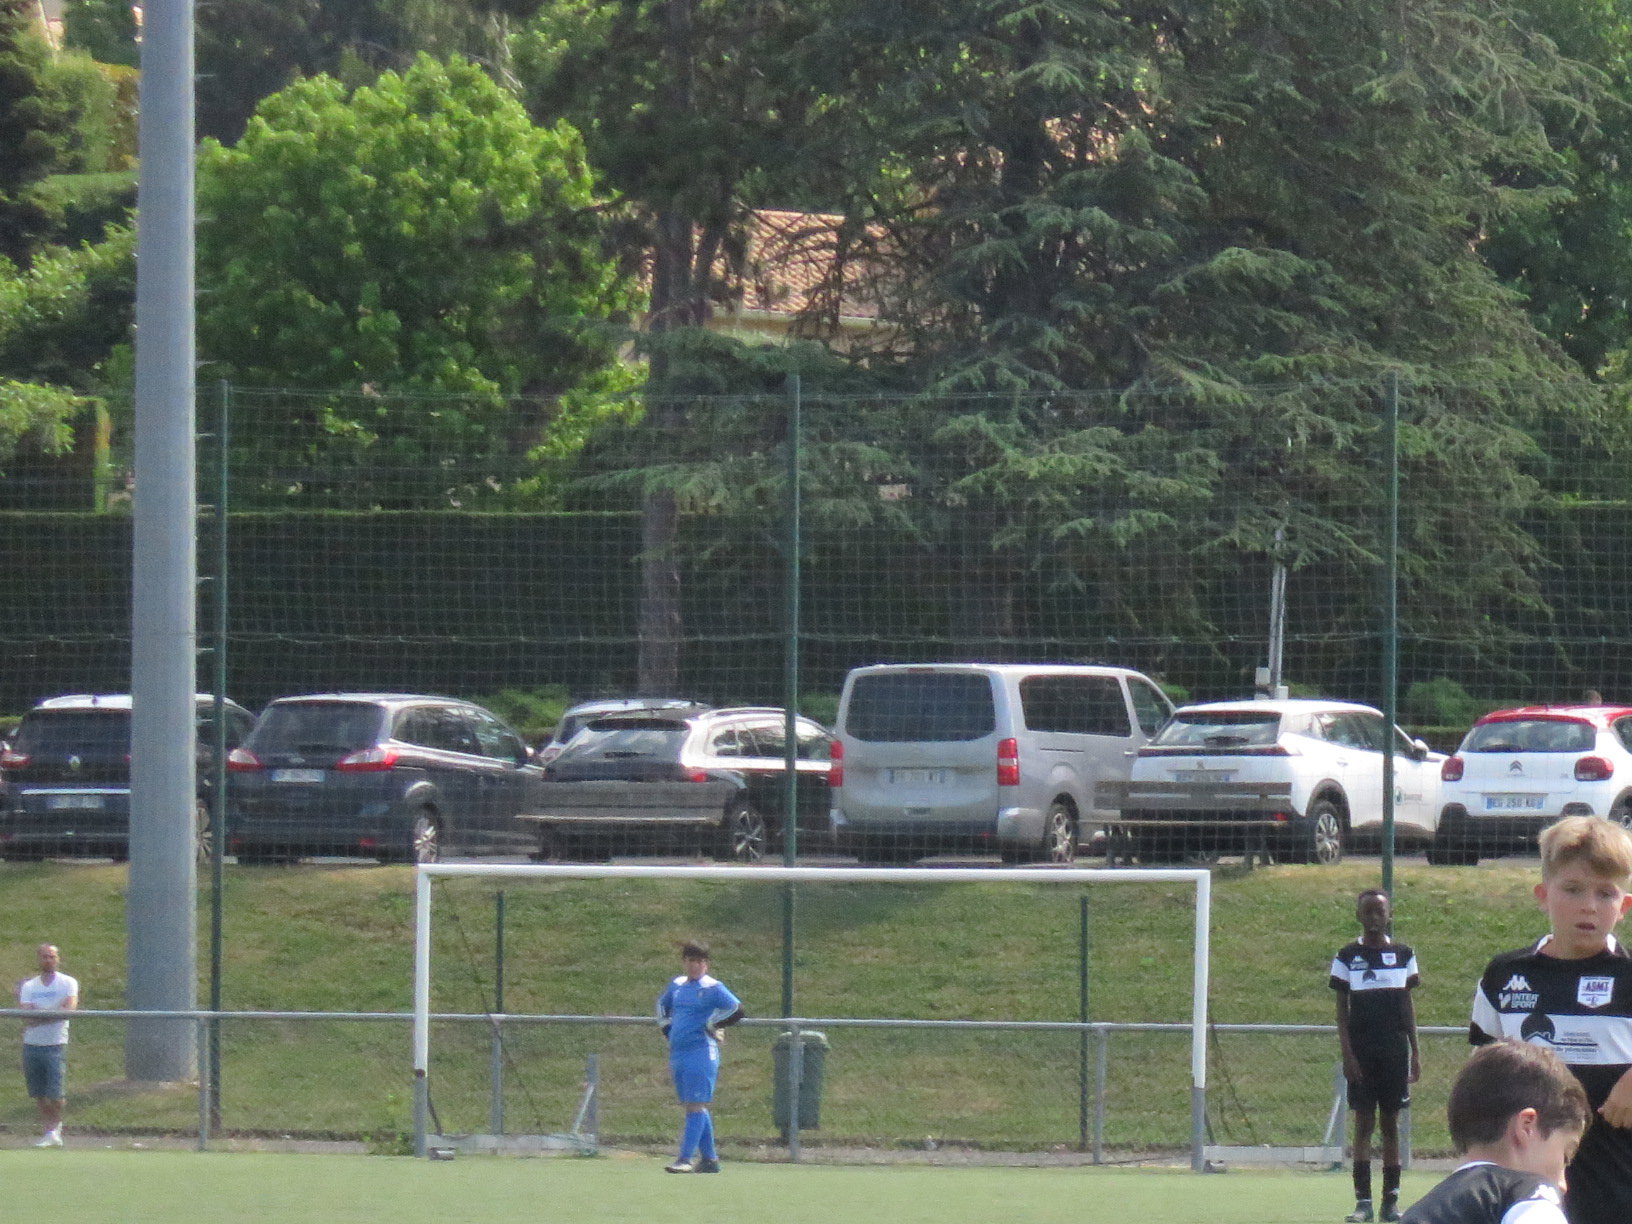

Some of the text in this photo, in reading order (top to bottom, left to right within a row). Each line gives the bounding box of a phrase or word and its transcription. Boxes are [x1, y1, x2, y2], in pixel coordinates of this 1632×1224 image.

[1585, 981, 1609, 992] ASMT
[1511, 993, 1539, 1001] INTER
[1511, 1001, 1537, 1009] SPORT
